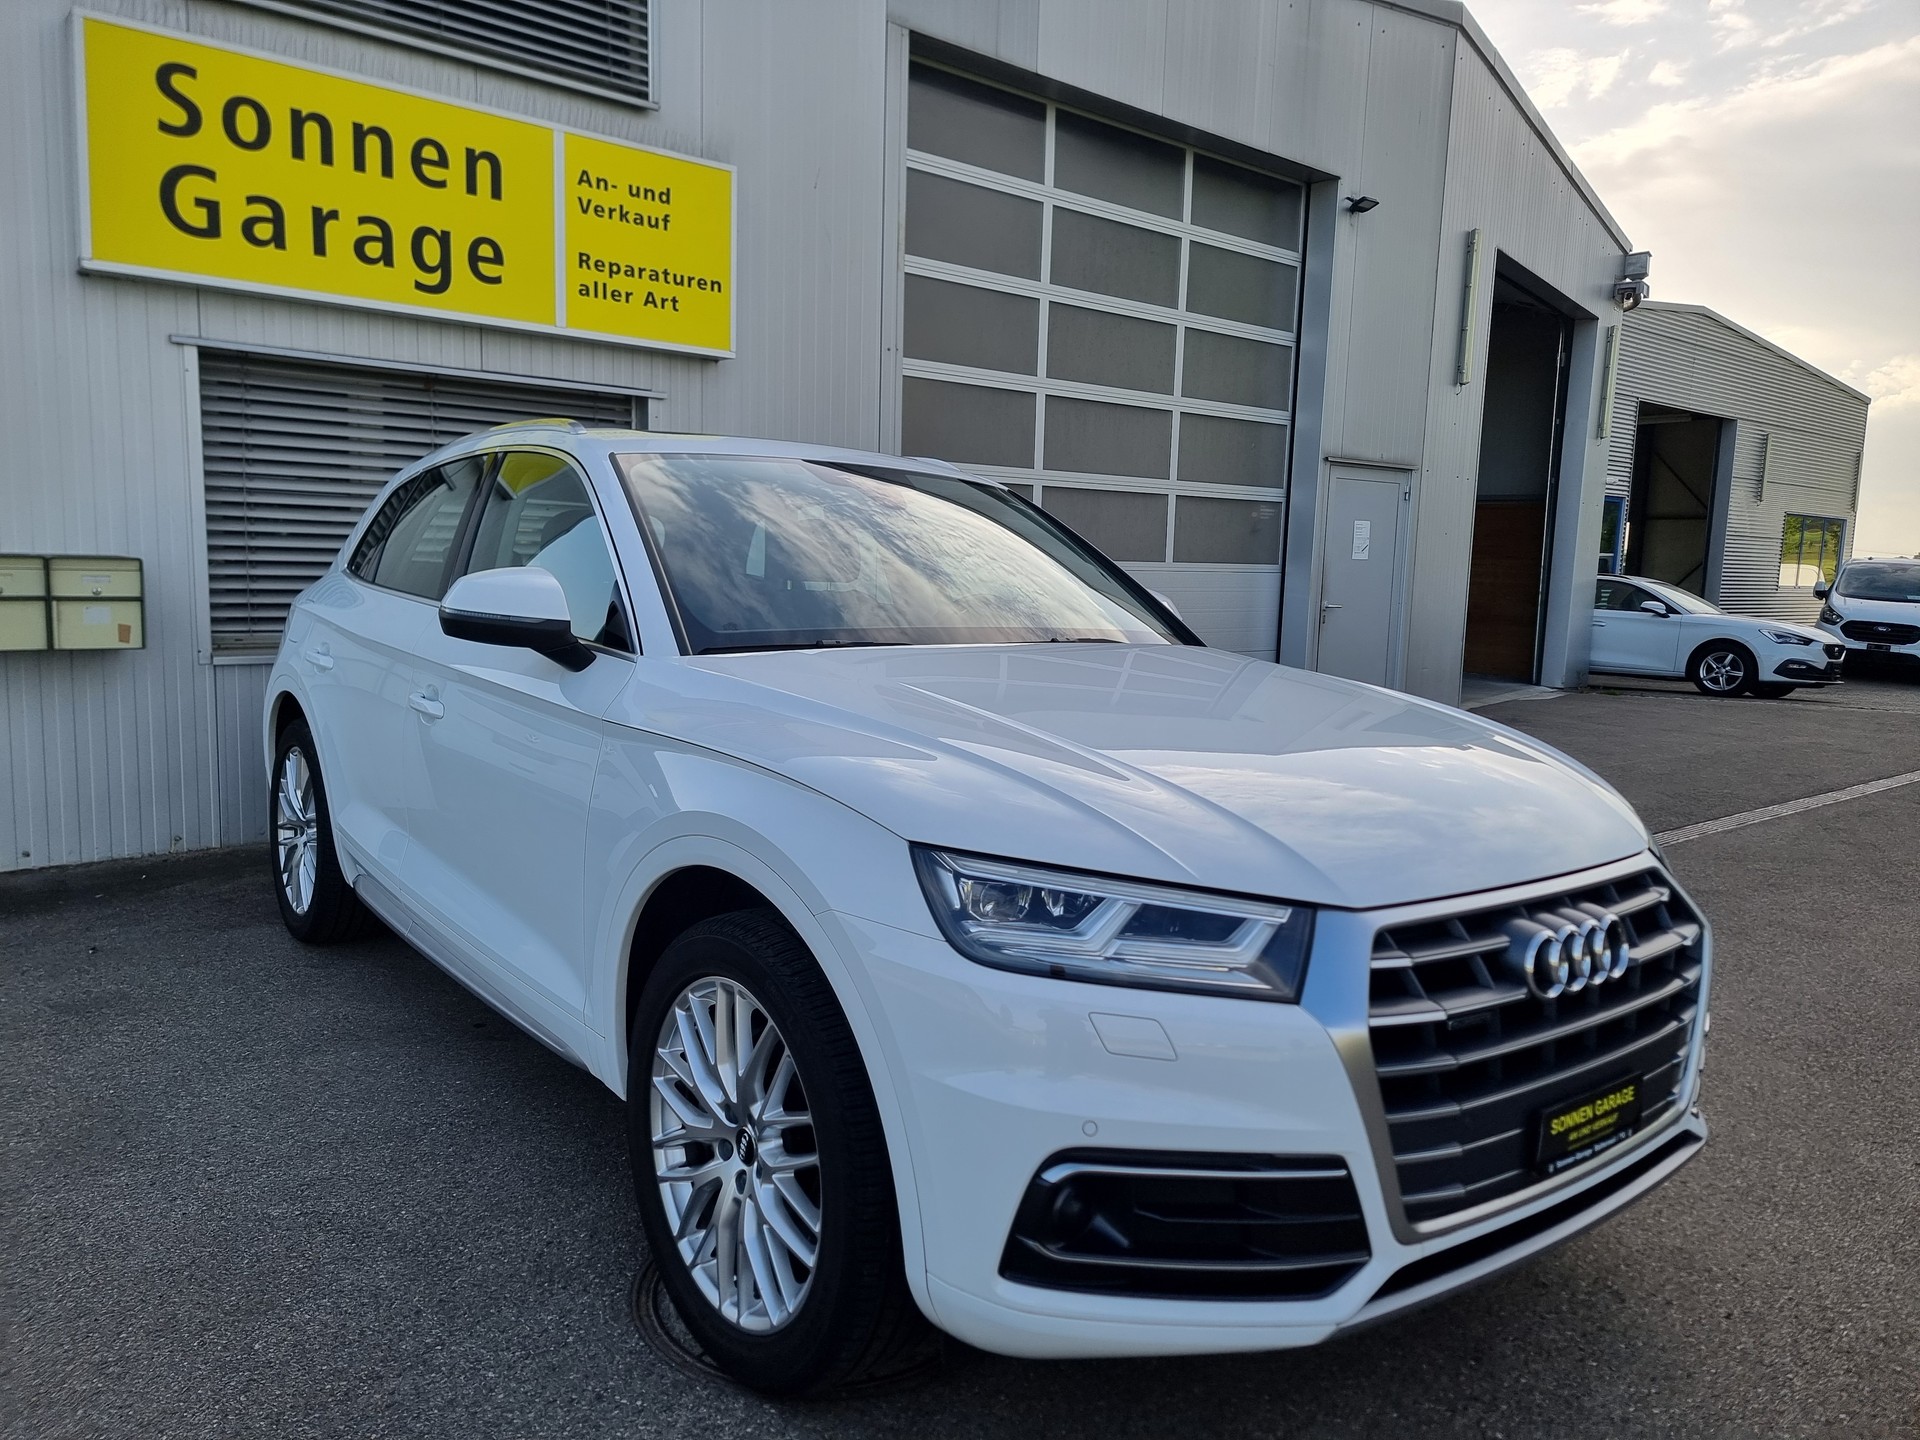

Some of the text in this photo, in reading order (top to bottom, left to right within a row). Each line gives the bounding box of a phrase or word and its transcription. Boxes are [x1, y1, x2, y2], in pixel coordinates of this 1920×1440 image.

[154, 61, 503, 202] Sonnen
[577, 169, 671, 206] An- und
[158, 163, 505, 295] Garage
[577, 196, 671, 232] Verkauf
[578, 251, 722, 294] Reparaturen
[578, 280, 680, 313] aller Art
[1550, 1085, 1635, 1135] SONNEN GARAGE
